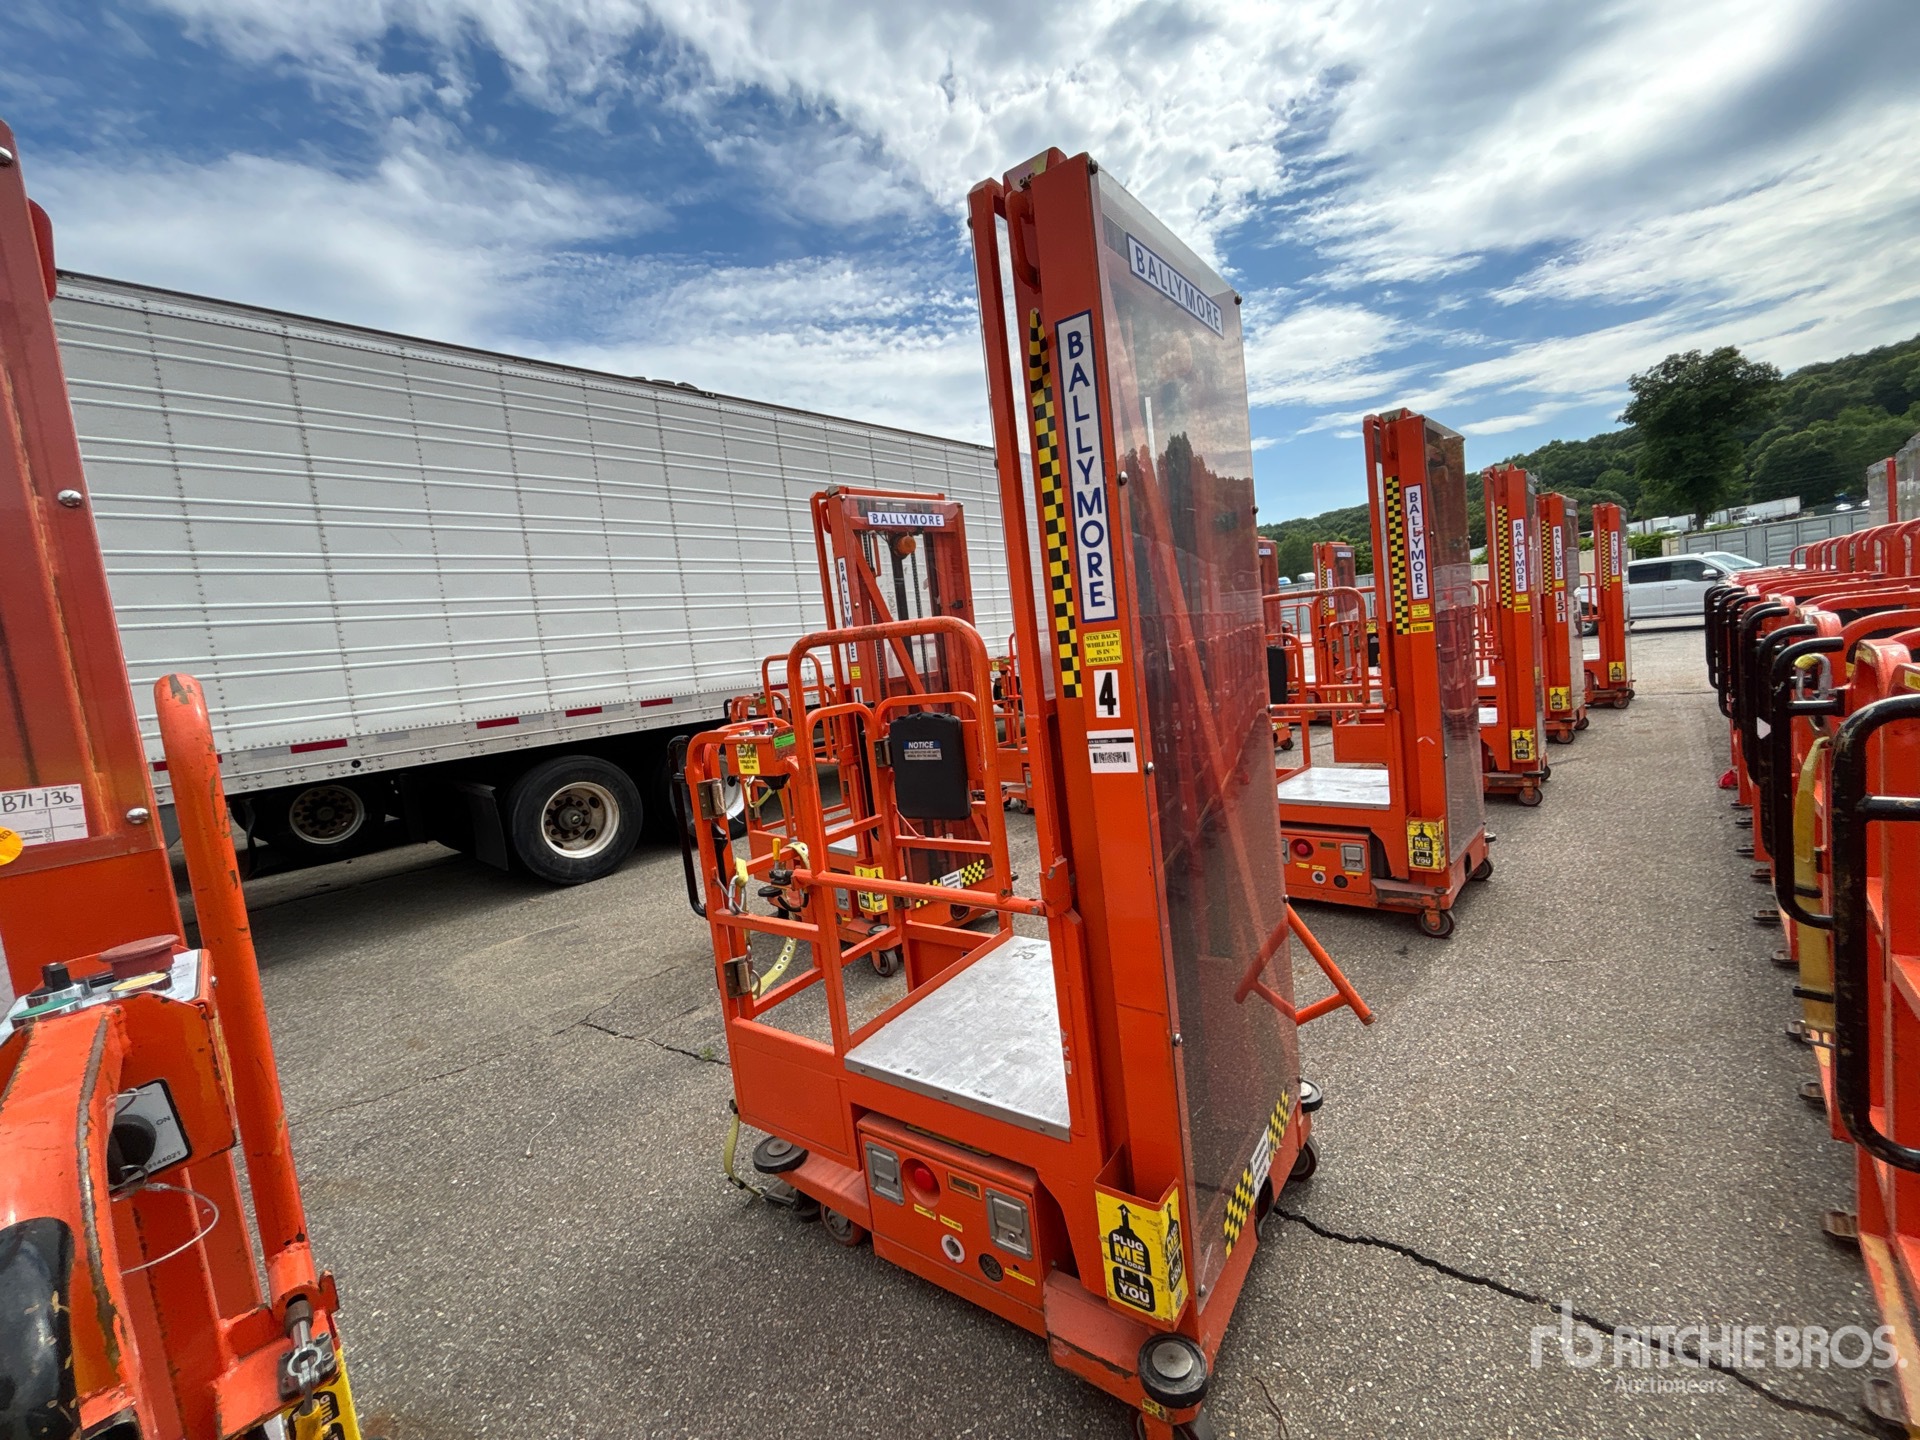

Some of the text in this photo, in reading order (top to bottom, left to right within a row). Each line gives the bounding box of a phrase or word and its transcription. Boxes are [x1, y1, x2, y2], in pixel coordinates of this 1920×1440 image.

[1134, 245, 1220, 331] BALLYMORE
[1067, 330, 1106, 607] BALLYMORE
[872, 513, 941, 525] BALLYMORE
[1409, 492, 1425, 595] BALLYMORE
[1515, 523, 1525, 590] BALLYMORE
[1101, 632, 1118, 640] BACK
[1098, 672, 1117, 716] 4
[908, 741, 934, 749] NOTICE
[1, 791, 74, 813] B71-136
[155, 1116, 171, 1126] ON
[1112, 1233, 1144, 1252] PLUG
[1114, 1242, 1146, 1266] ME
[1124, 1259, 1146, 1272] TODAY
[1118, 1282, 1150, 1304] YOU
